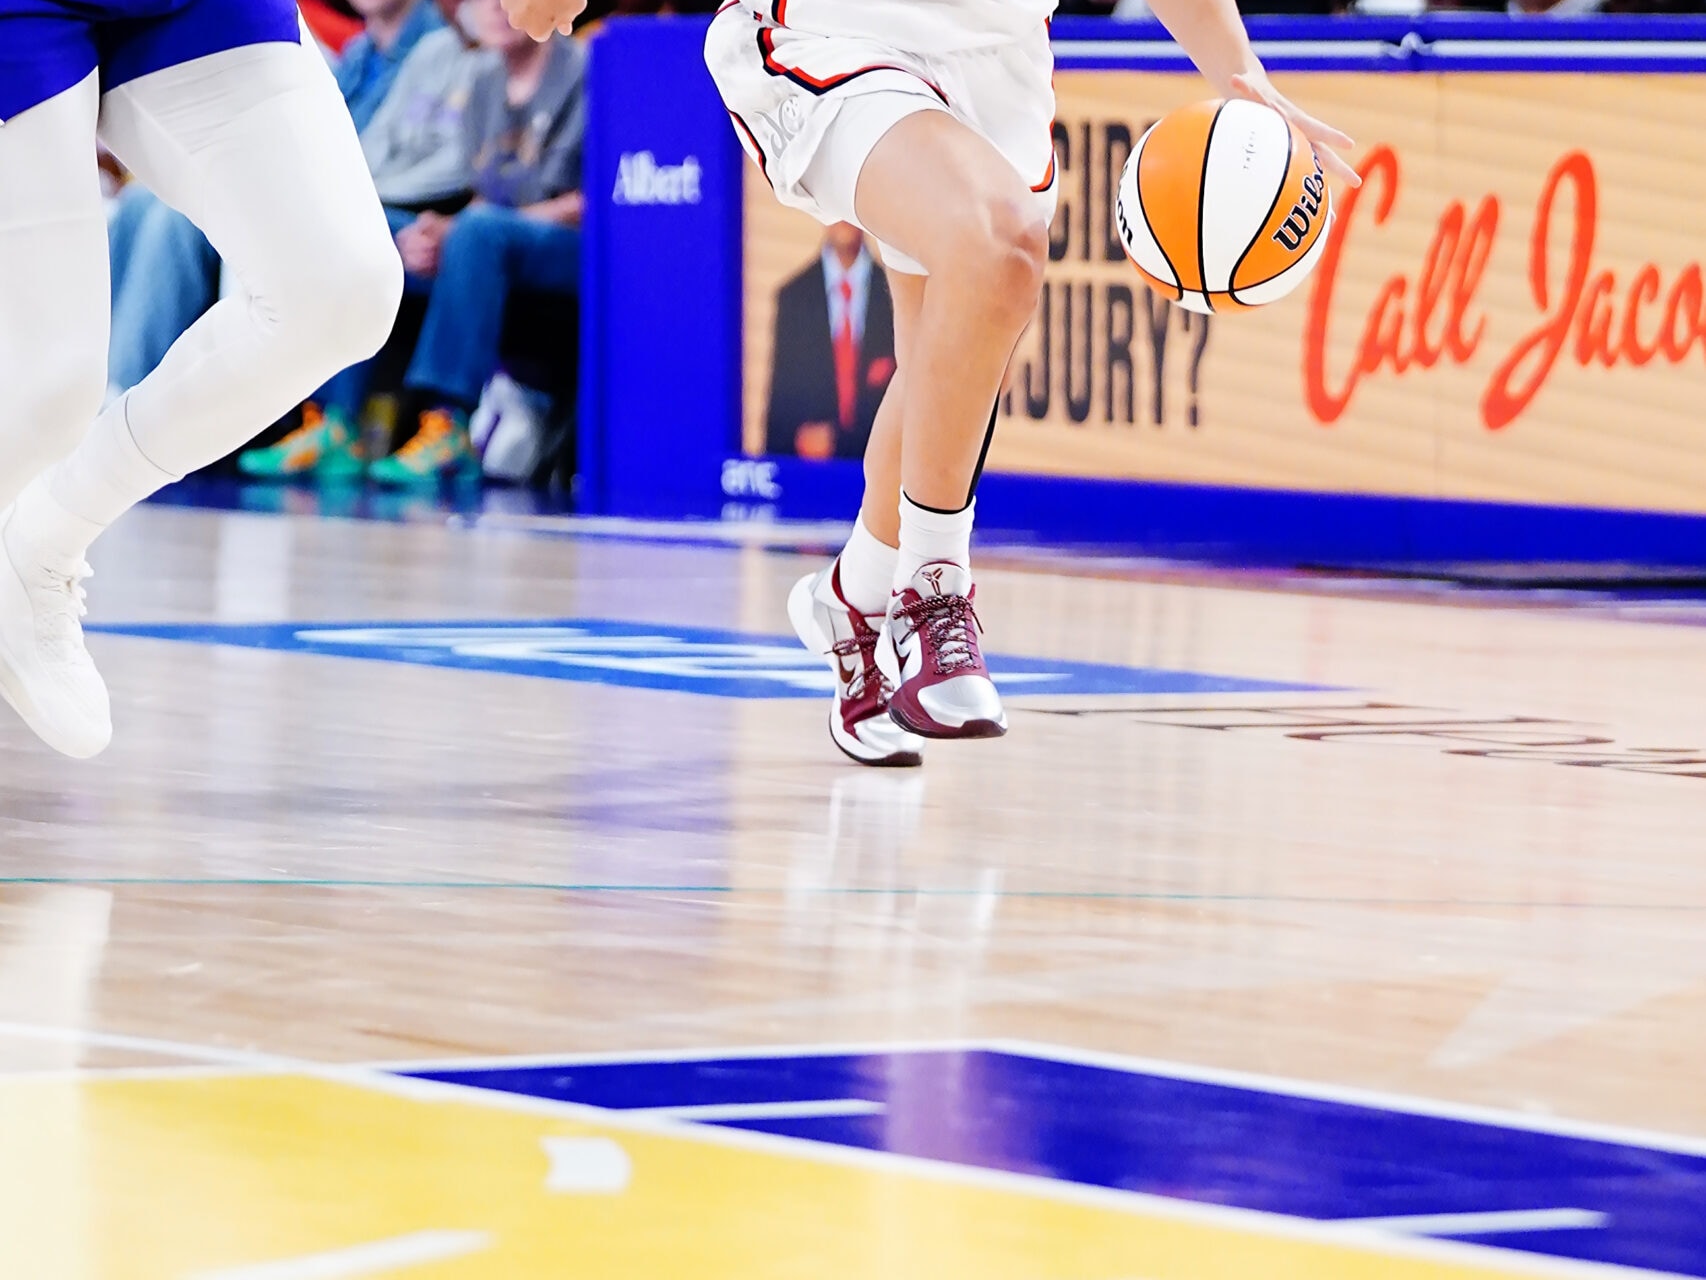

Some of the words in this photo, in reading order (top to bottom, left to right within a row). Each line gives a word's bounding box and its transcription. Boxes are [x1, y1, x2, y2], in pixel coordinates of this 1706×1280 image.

[612, 150, 702, 206] Albert
[1004, 282, 1211, 427] JURY?
[1304, 141, 1500, 426] Call
